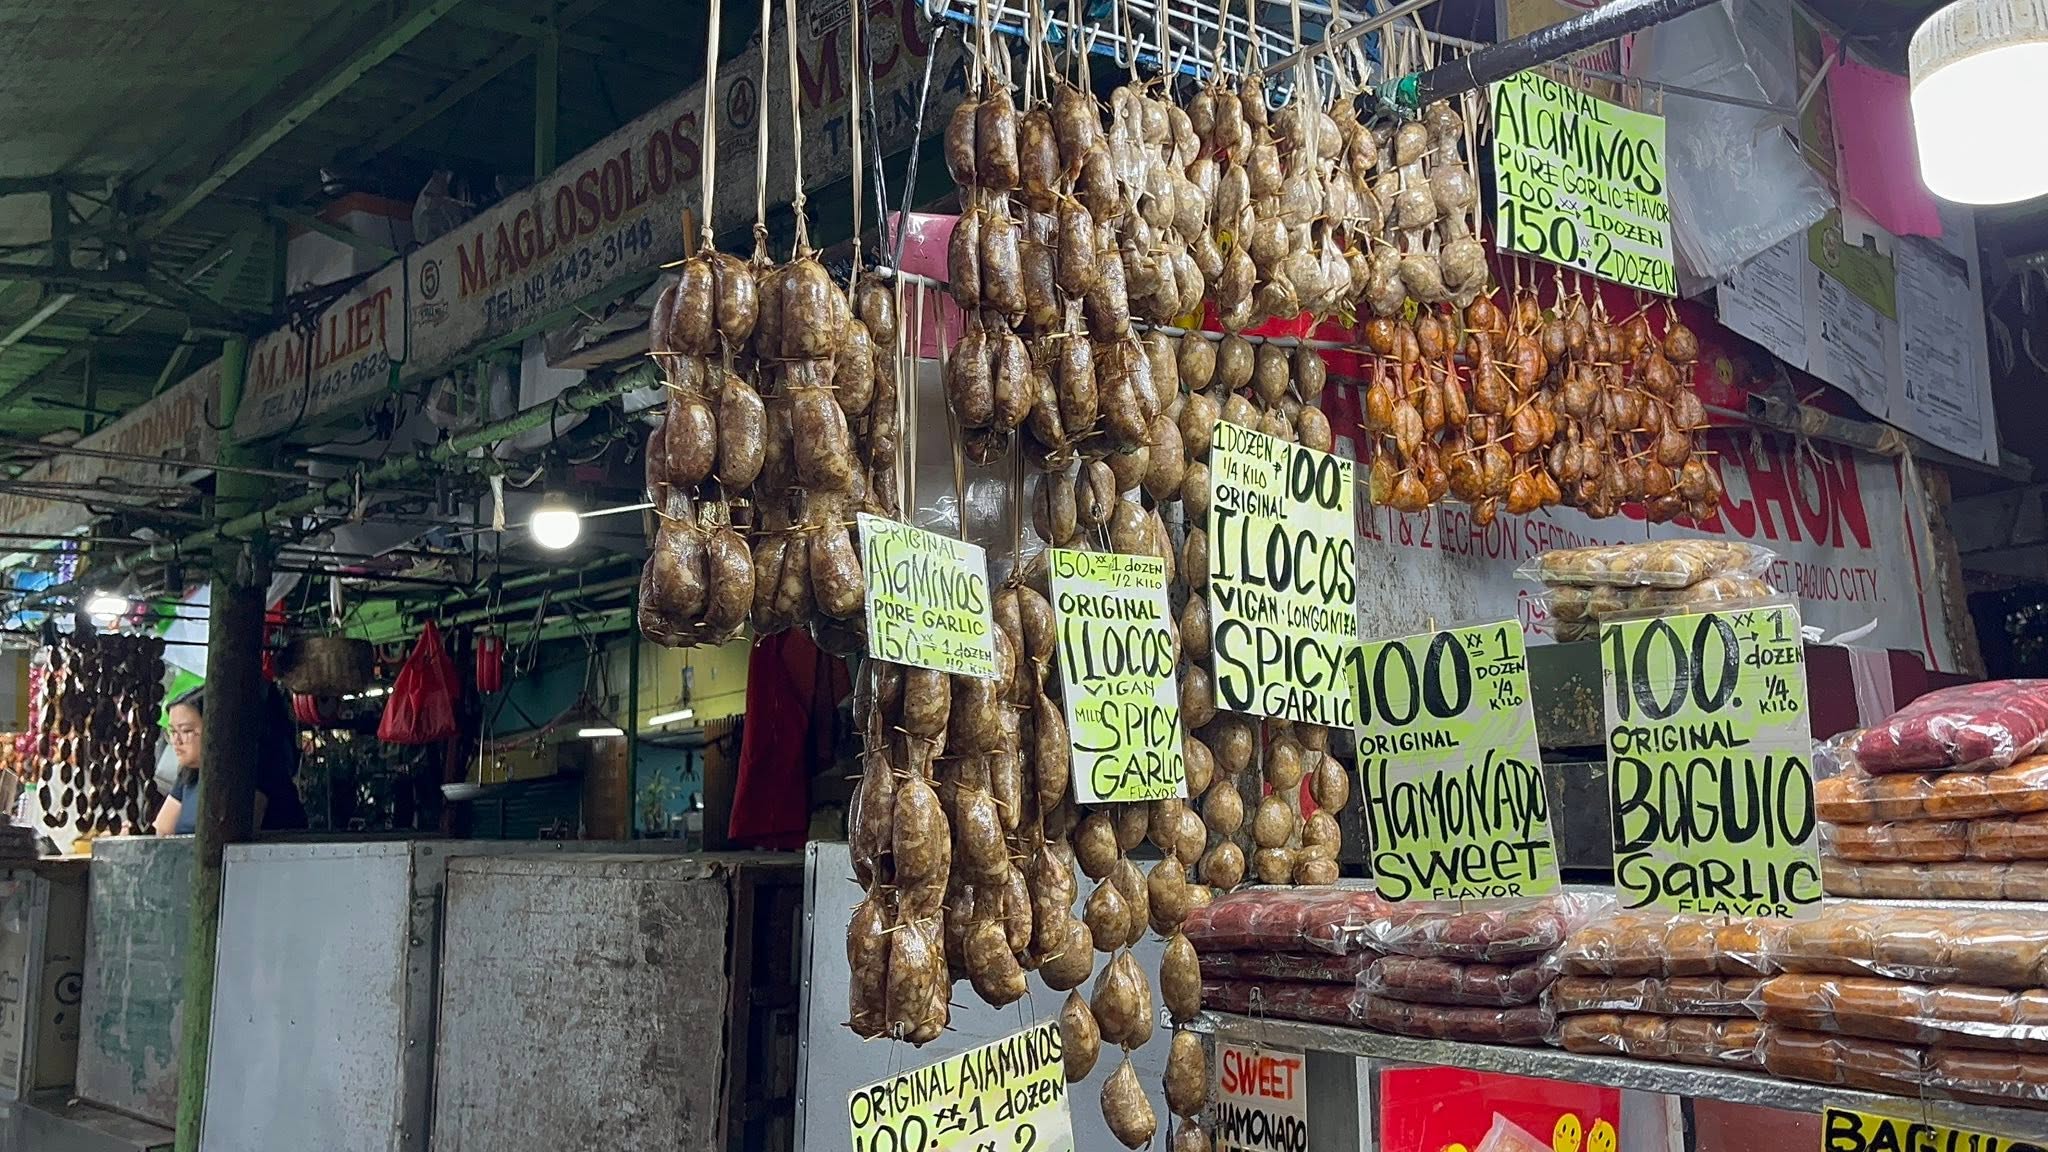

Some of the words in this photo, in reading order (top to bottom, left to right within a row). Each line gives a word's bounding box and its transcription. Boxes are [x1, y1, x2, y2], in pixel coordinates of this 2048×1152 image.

[1499, 142, 1558, 187] PURE
[1583, 205, 1601, 230] 1
[1600, 213, 1664, 249] DOZEN
[1594, 233, 1613, 277] 2
[1212, 421, 1225, 451] 1
[1243, 463, 1267, 489] KILO
[1216, 484, 1288, 519] ORIGINAL
[1437, 504, 1517, 560] LECHON
[1211, 504, 1356, 606] ILOCOS
[1112, 573, 1132, 588] 1/2
[1136, 577, 1163, 590] KILO
[1795, 560, 1838, 601] BAGUIO
[922, 610, 985, 637] GARLIC
[1058, 592, 1161, 621] ORIGINAL
[1766, 609, 1792, 643] 1
[1063, 617, 1174, 685] ILOCOS
[1492, 628, 1519, 662] 1
[1215, 618, 1343, 712] SPICY
[1475, 655, 1525, 680] DOZEN
[1083, 680, 1156, 697] VIGAN
[1489, 697, 1523, 711] KILO
[1765, 673, 1789, 701] 1/4
[1075, 707, 1102, 724] MILD
[1759, 700, 1799, 715] KILO
[1073, 701, 1179, 752] SPICY
[1360, 729, 1460, 755] ORIGINAL
[1610, 719, 1750, 756] ORIGINAL
[1091, 751, 1184, 800] GARLIC
[1130, 785, 1179, 800] FLAVOR
[1678, 898, 1793, 919] FLAVOR
[1220, 1049, 1302, 1100] SWEET
[850, 1061, 955, 1129] ORIGINAL
[968, 1095, 989, 1136] 1
[1216, 1101, 1307, 1152] HAMONADO
[1825, 1108, 2048, 1152] BAGU
